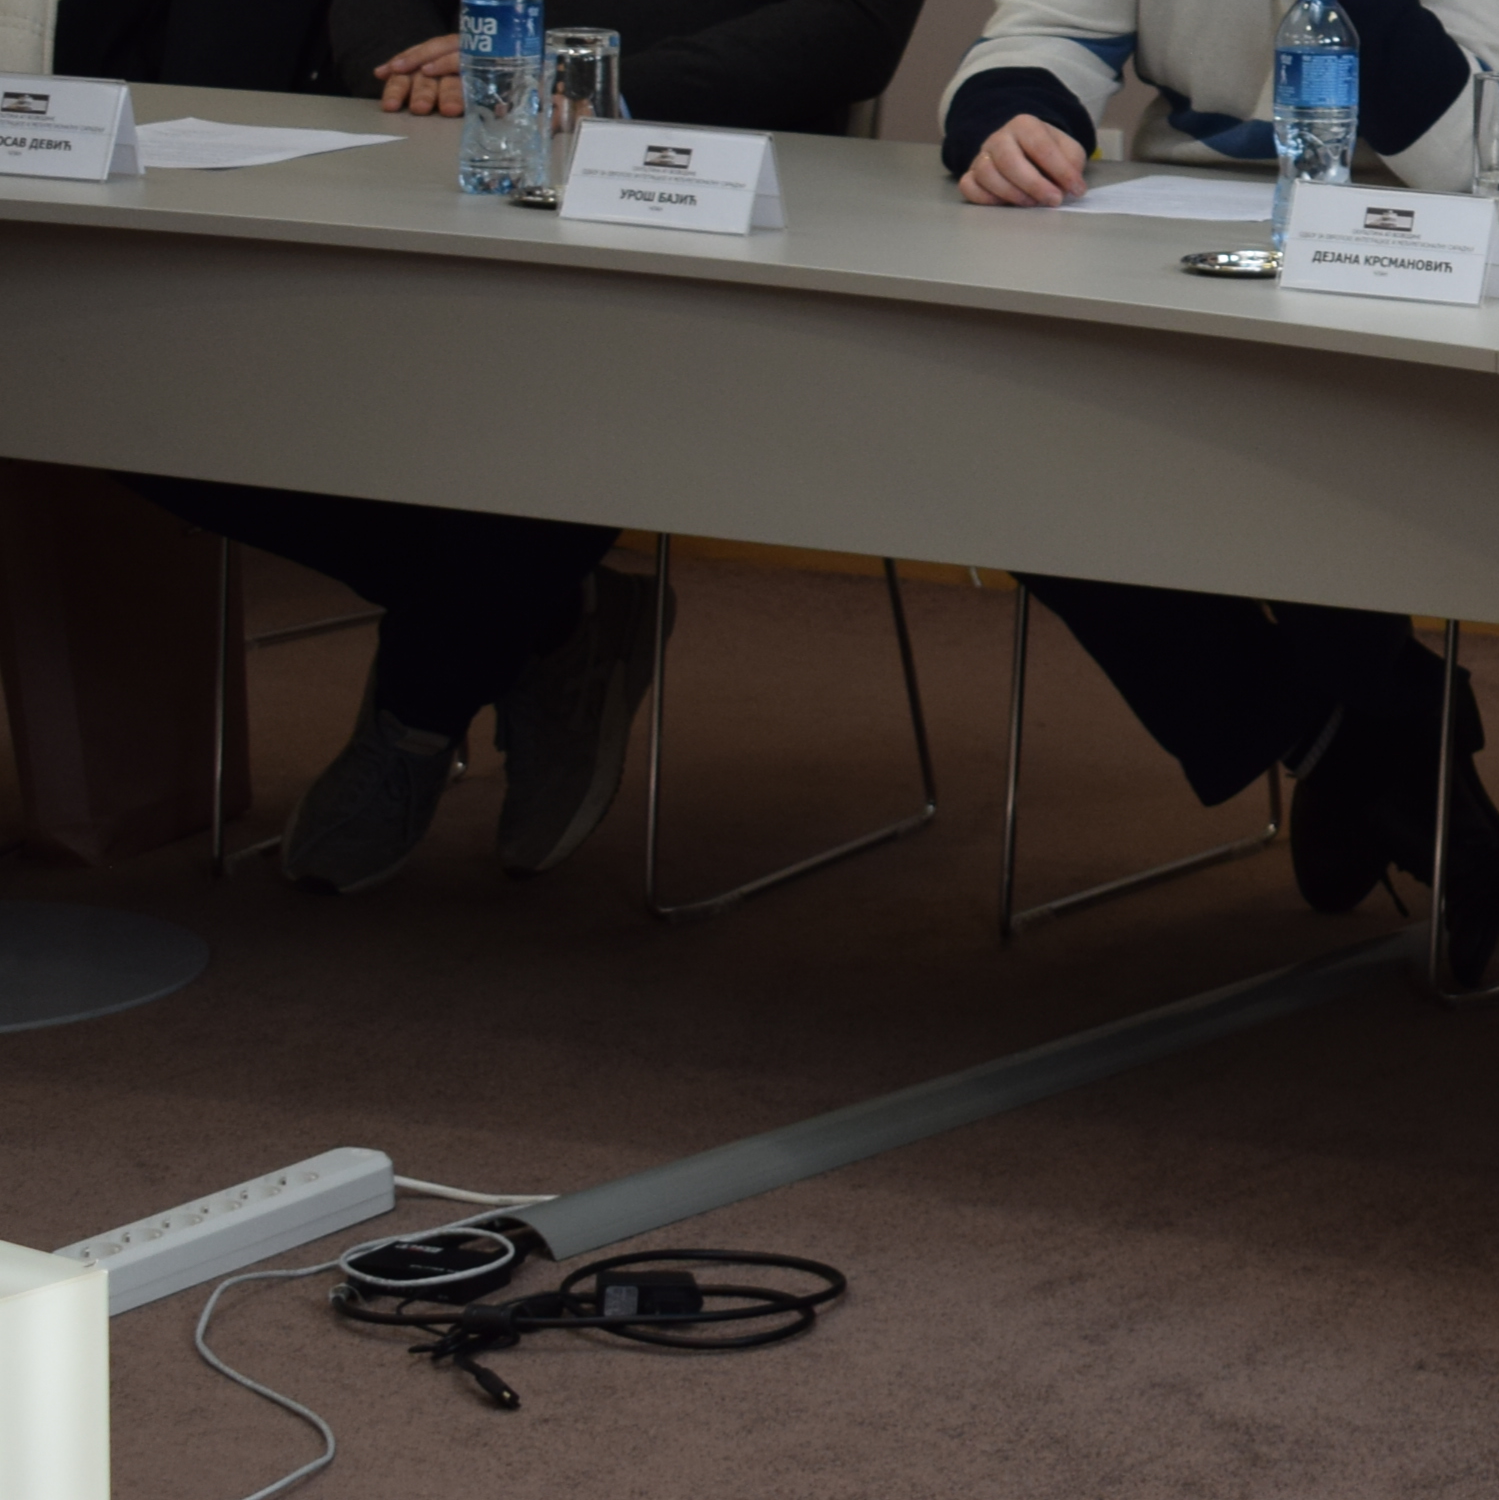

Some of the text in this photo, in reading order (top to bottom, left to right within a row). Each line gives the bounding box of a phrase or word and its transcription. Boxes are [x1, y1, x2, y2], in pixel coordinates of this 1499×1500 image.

[460, 16, 497, 35] qua
[29, 138, 72, 151] ДЕВИЋ
[619, 188, 698, 206] УРОШ БАЈИЋ
[1312, 250, 1453, 273] ДЕЈАНА КРСМАНОВИЋ
